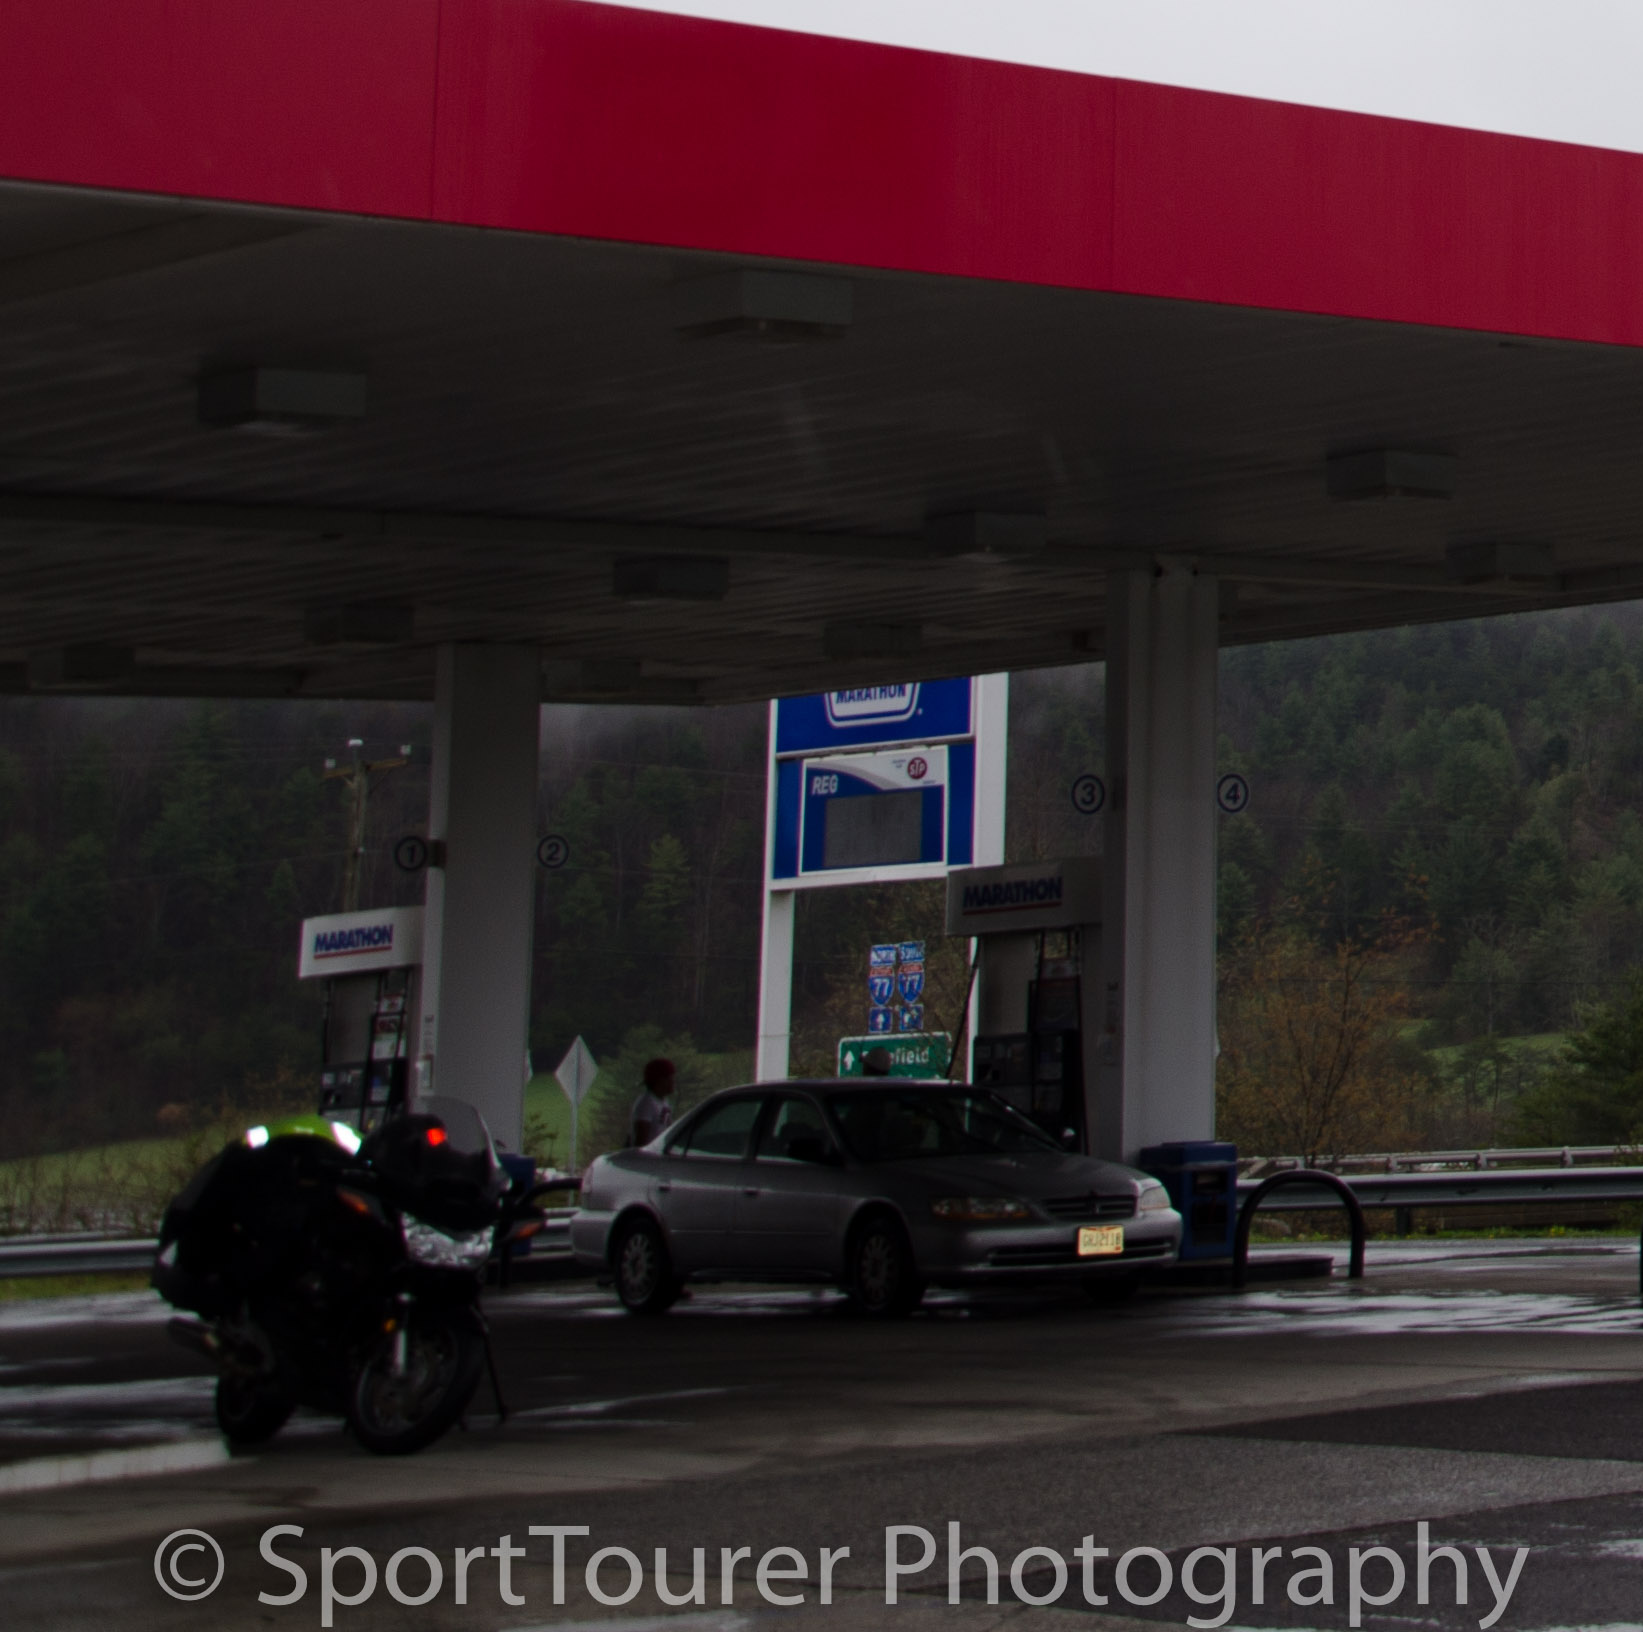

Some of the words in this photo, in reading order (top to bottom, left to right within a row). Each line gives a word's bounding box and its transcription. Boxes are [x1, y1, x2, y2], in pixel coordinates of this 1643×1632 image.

[812, 774, 838, 796] REG
[1082, 782, 1095, 805] 3
[1226, 783, 1240, 804] 4
[547, 843, 560, 862] 2
[963, 877, 1063, 908] MARATHON
[315, 924, 394, 953] MARATHON
[873, 978, 890, 997] 77
